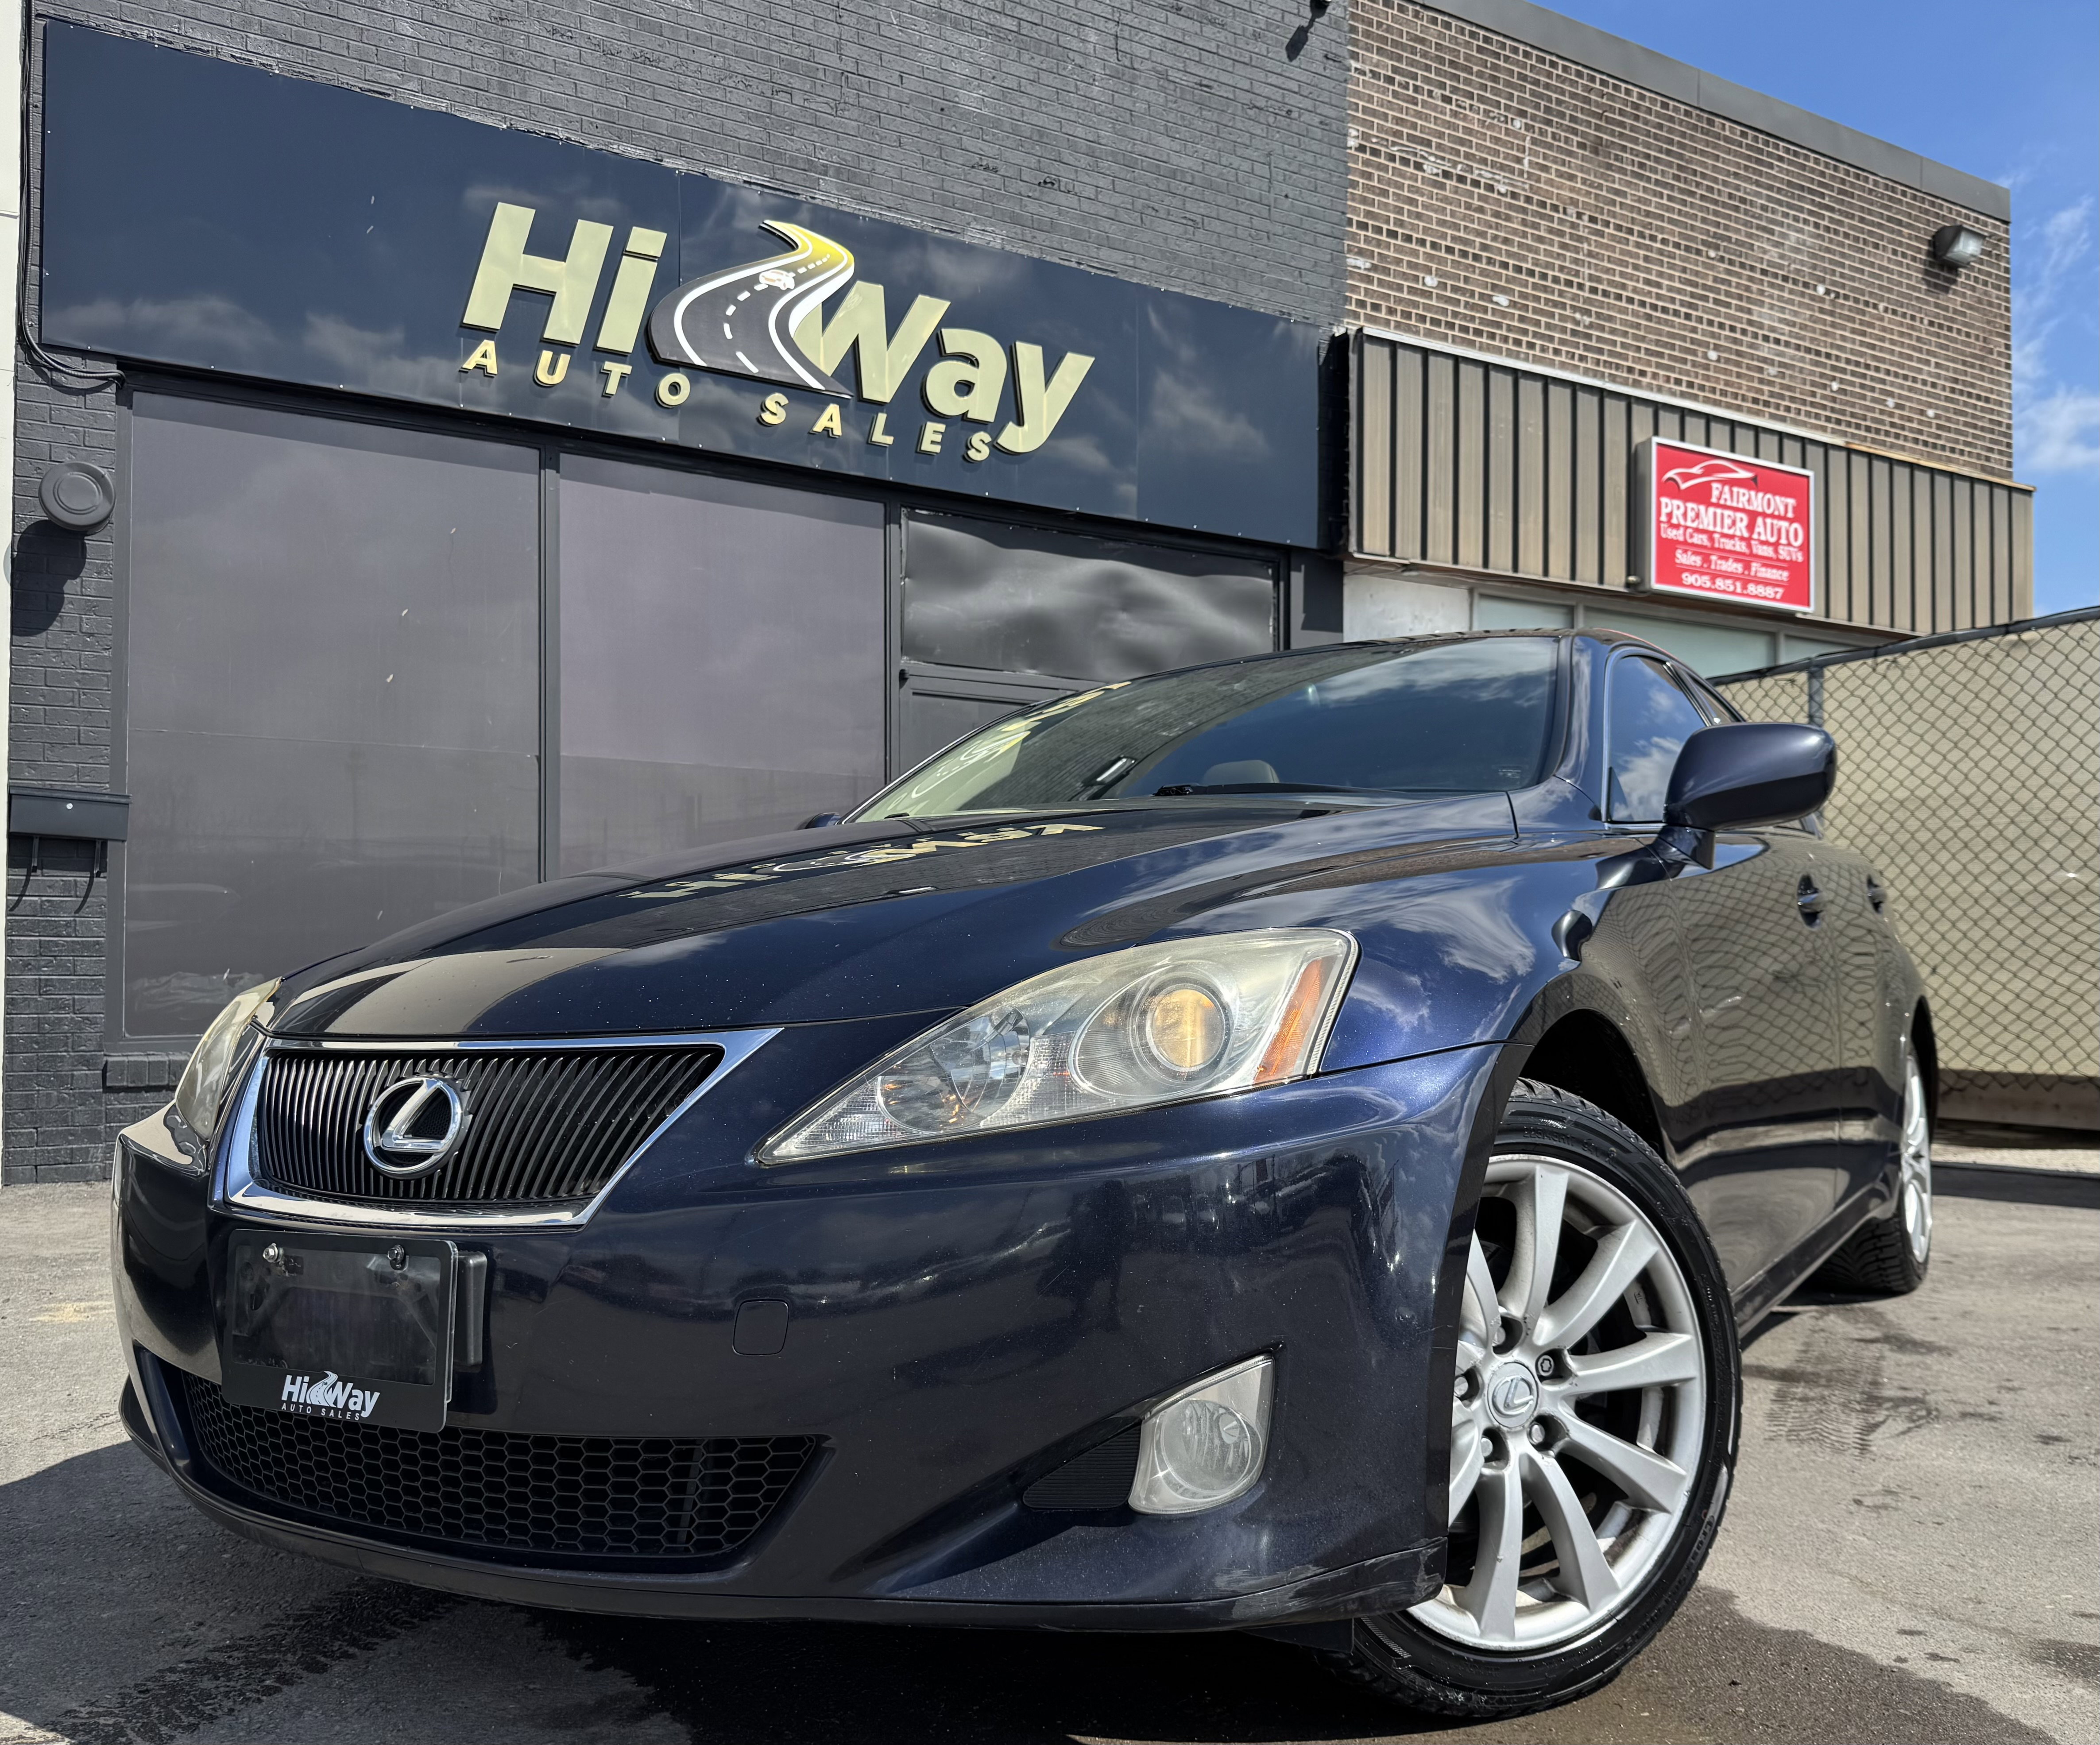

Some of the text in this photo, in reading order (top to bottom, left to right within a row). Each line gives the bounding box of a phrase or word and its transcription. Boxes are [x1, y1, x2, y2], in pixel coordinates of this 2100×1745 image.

[462, 339, 993, 462] AUTO SALES
[1711, 482, 1796, 518] FAIRMONT
[1659, 497, 1804, 546] PREMIER AUTO
[1660, 522, 1683, 541] Used
[1675, 549, 1789, 581] Sales Trades Finance
[281, 1403, 360, 1420] AUTO SALES
